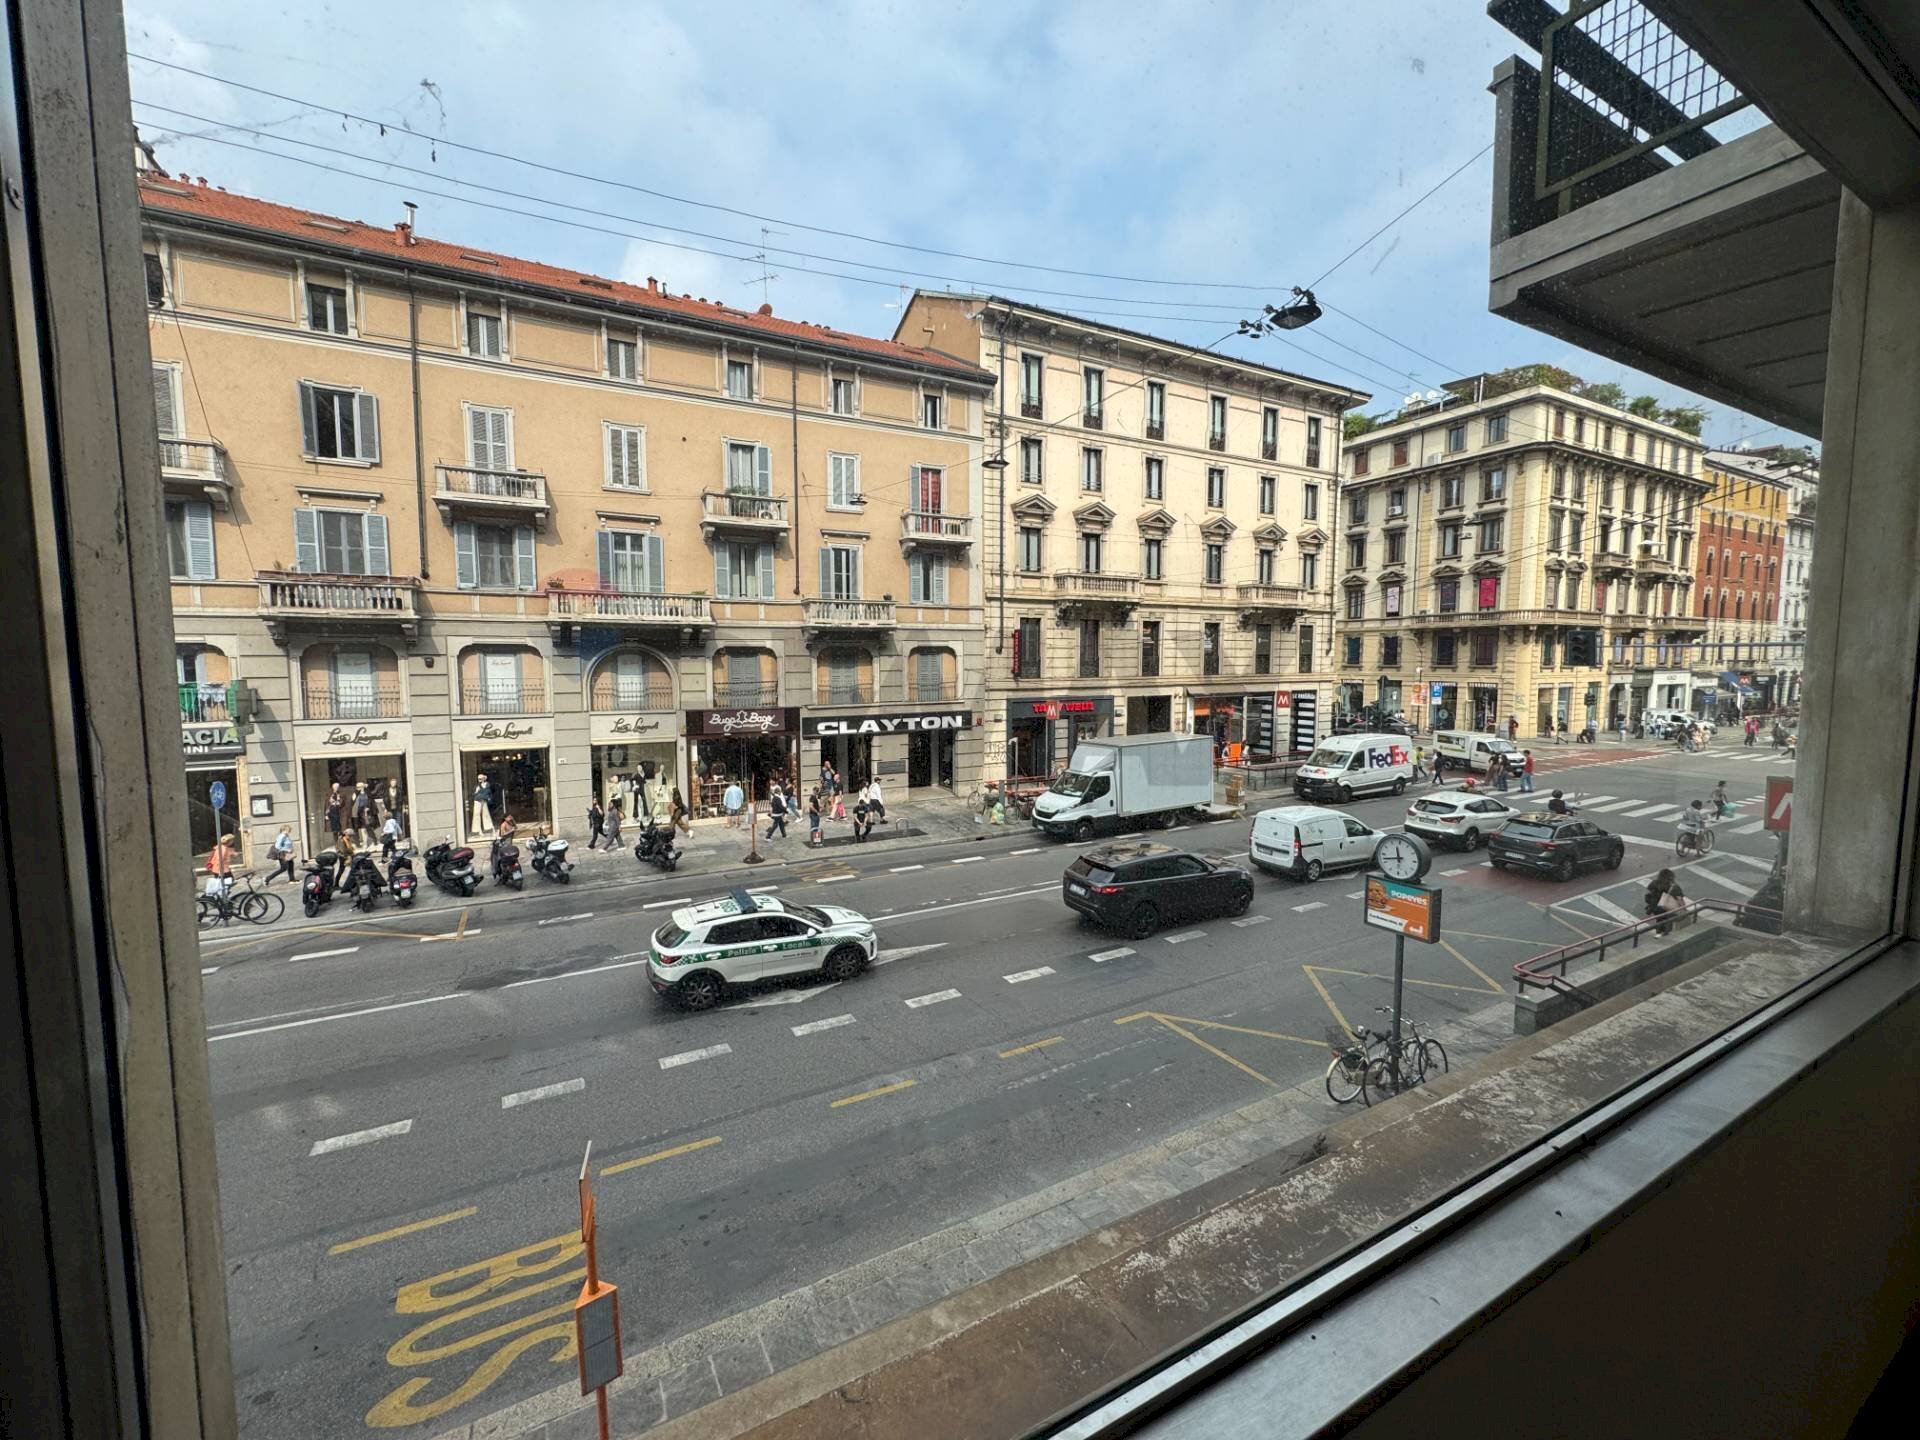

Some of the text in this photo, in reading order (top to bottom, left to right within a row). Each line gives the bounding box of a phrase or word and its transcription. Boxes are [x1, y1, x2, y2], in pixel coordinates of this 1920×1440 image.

[1278, 695, 1289, 704] M
[816, 715, 963, 735] CLAYTON
[1368, 745, 1409, 769] FedEx
[728, 940, 812, 957] Polizia Locale
[365, 1226, 588, 1429] BUS
